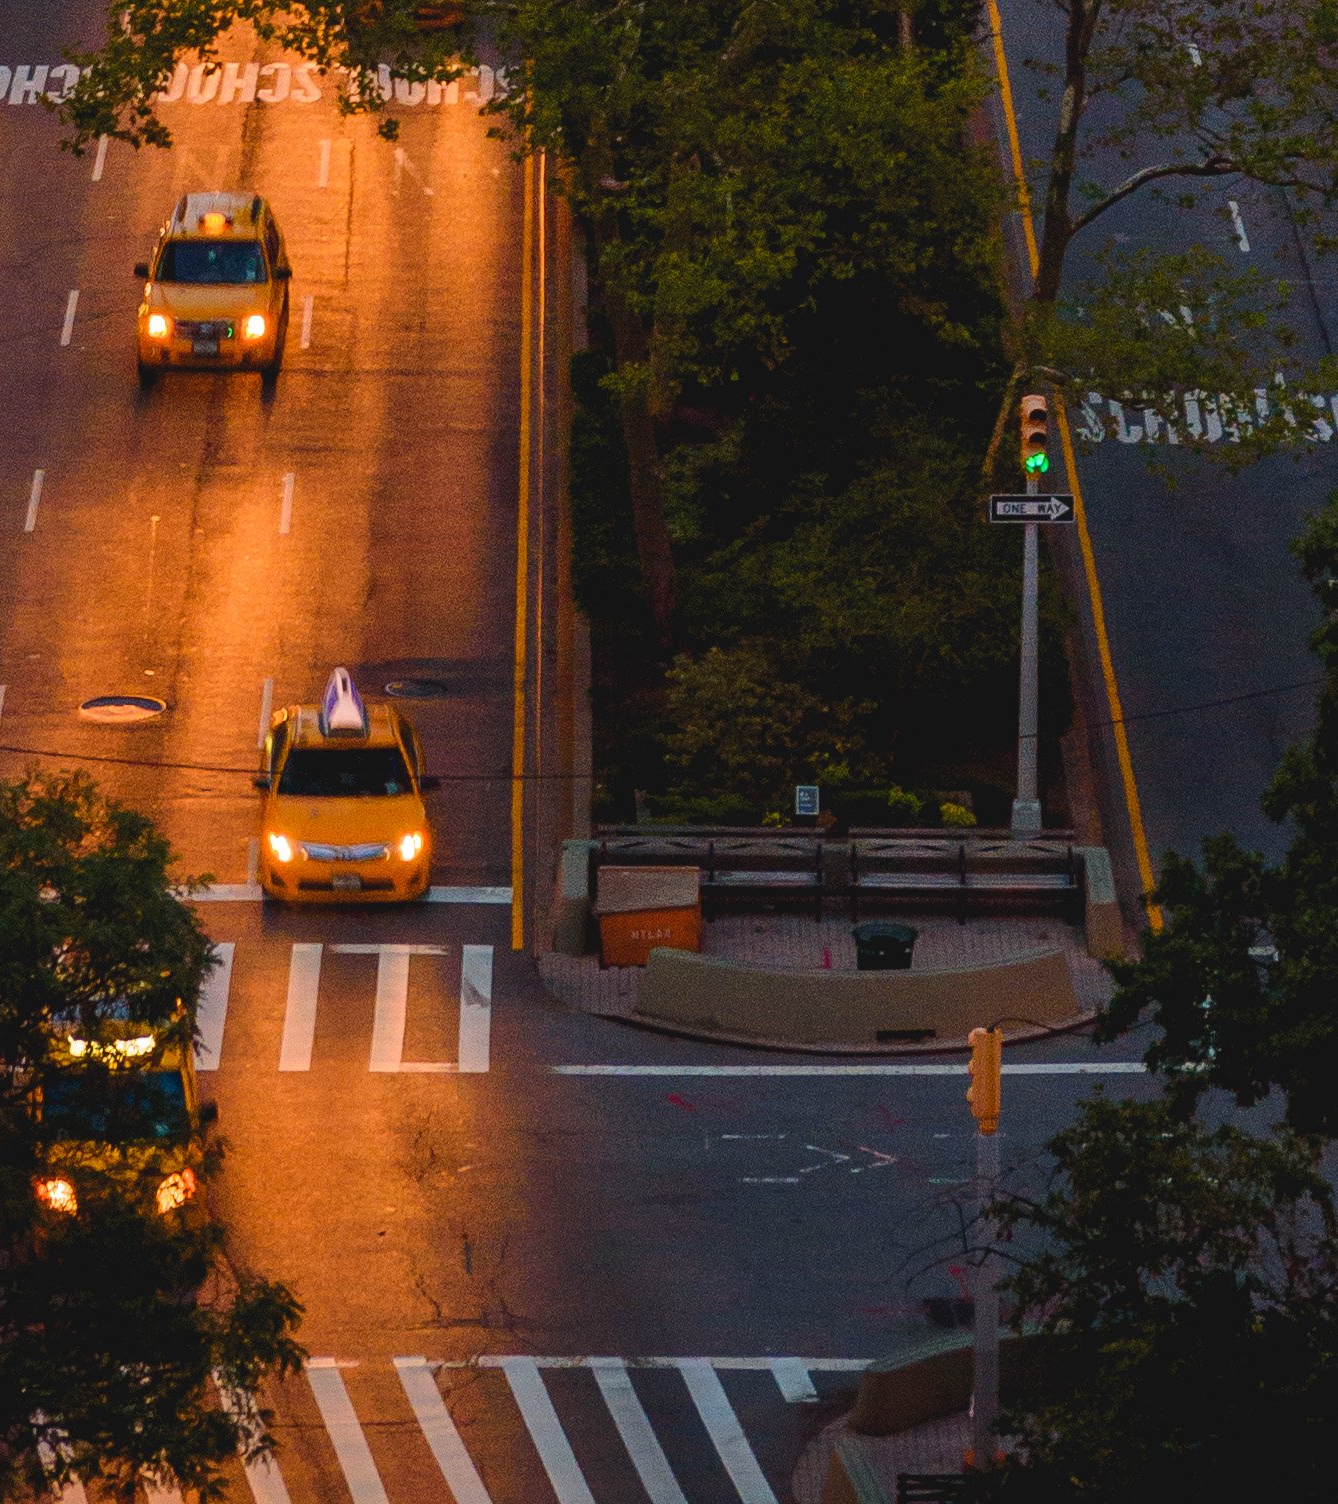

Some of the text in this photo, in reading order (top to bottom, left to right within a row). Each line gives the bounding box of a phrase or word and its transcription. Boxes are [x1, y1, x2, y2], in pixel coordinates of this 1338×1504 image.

[156, 62, 322, 105] SCHOO
[1002, 503, 1062, 515] ONE WAY
